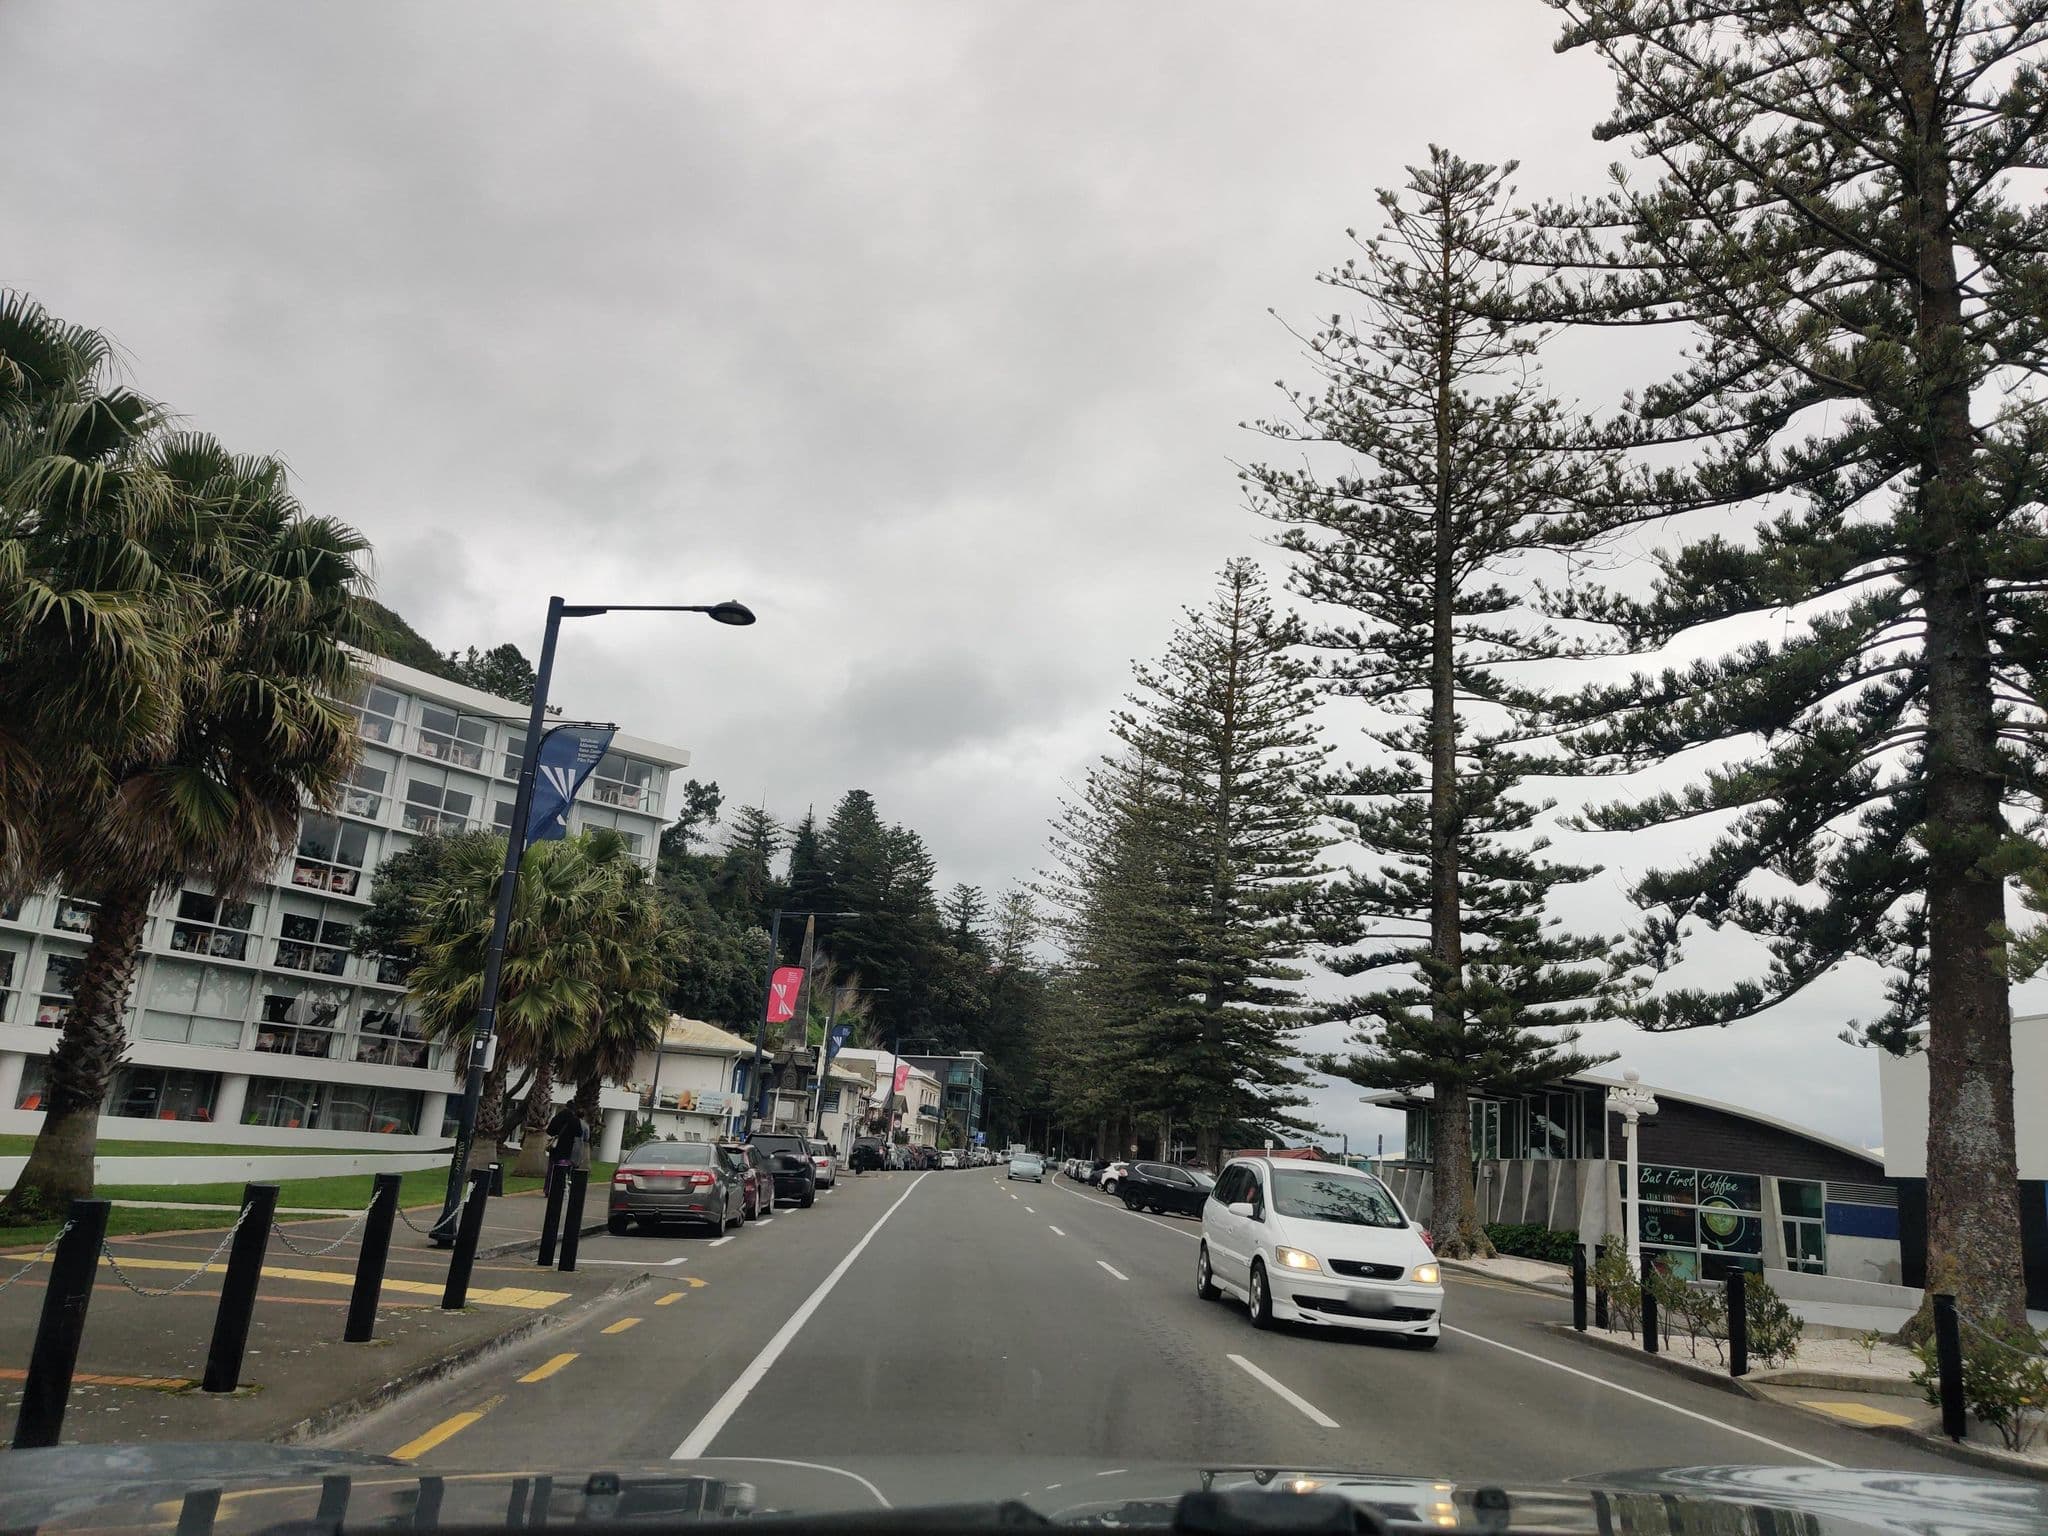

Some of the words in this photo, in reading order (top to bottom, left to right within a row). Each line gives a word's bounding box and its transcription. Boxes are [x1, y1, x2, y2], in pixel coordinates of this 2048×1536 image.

[1640, 1167, 1662, 1184] But
[1666, 1170, 1695, 1186] First
[1701, 1174, 1738, 1195] Coffee
